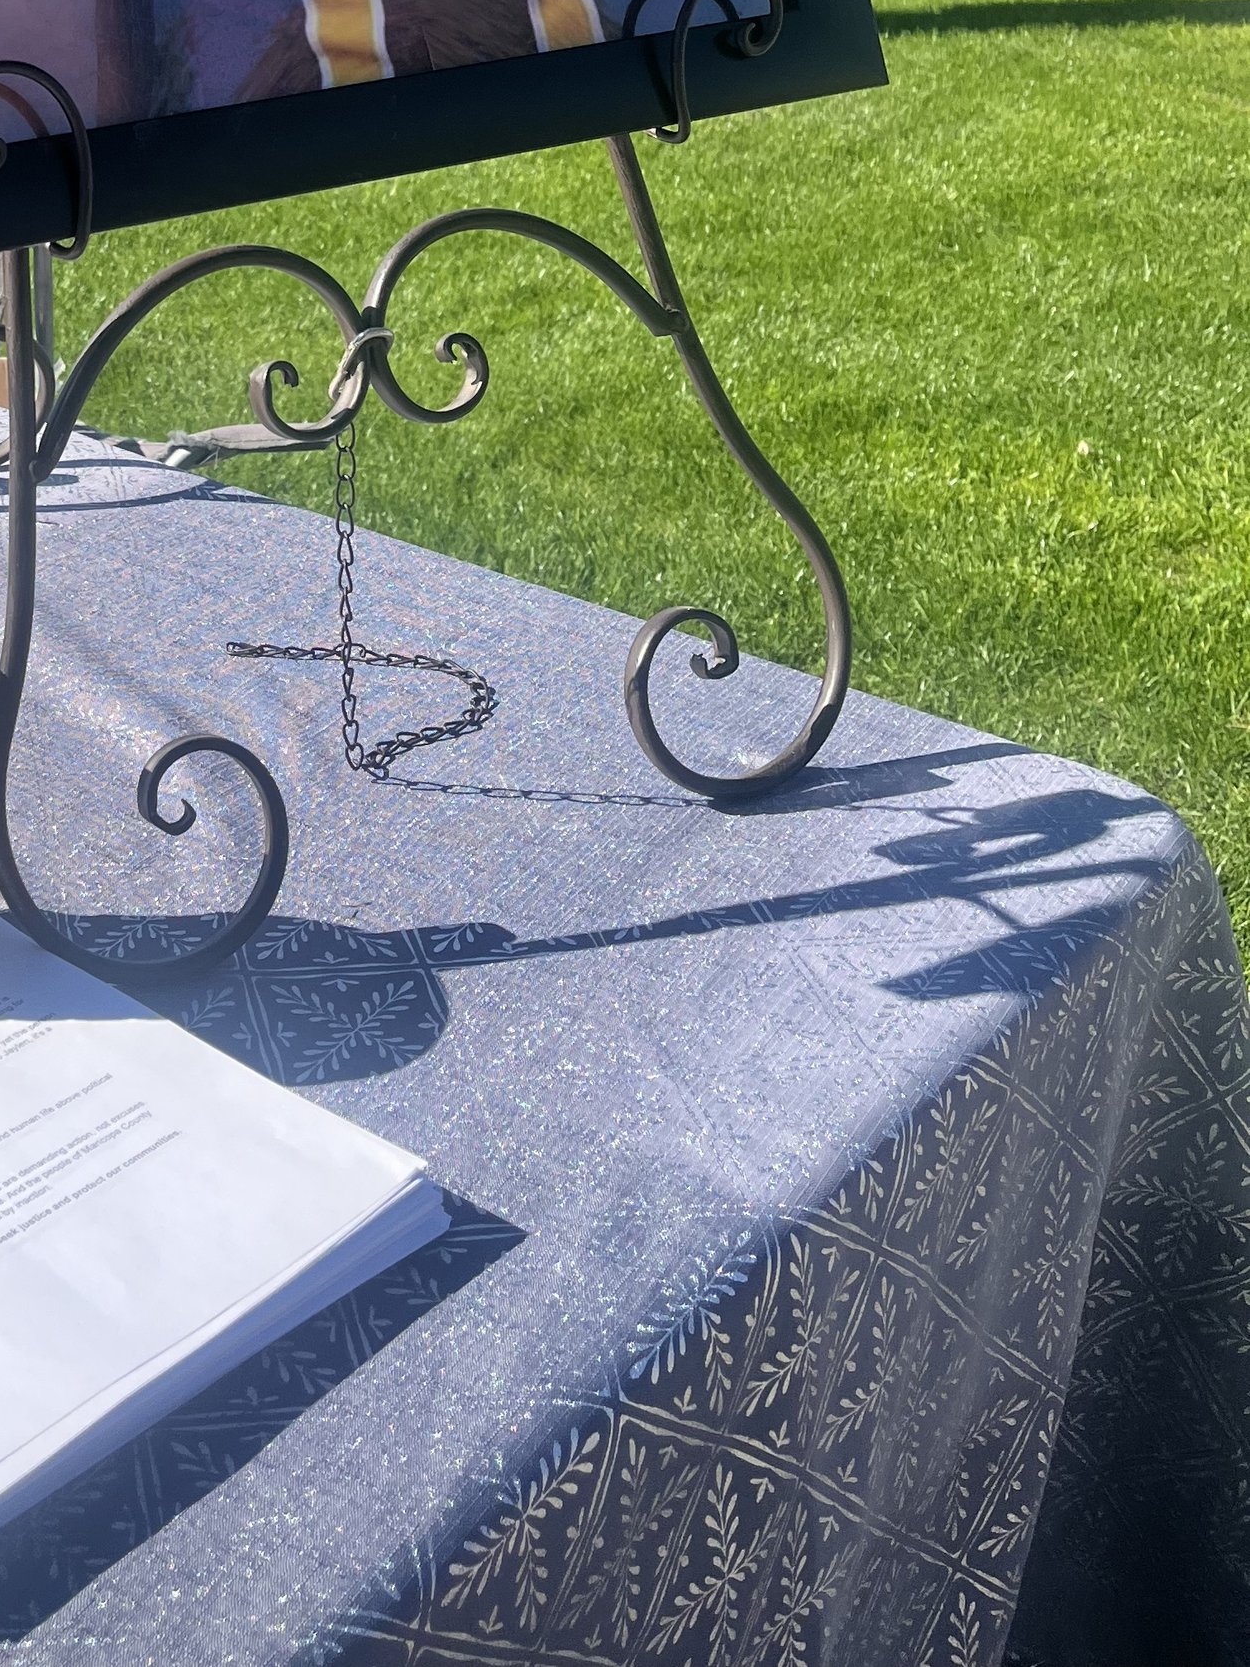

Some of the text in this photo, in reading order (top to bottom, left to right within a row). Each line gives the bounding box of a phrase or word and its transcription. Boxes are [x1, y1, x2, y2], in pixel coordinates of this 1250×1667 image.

[10, 1115, 41, 1133] human
[40, 1108, 55, 1116] life
[55, 1092, 82, 1108] above
[81, 1073, 113, 1094] political
[3, 1177, 19, 1187] are
[18, 1148, 68, 1177] demanding
[96, 1121, 111, 1131] not
[5, 1185, 27, 1198] And
[25, 1177, 42, 1187] the
[42, 1159, 72, 1179] people
[81, 1129, 122, 1153] Maricopa
[120, 1111, 154, 1130] County
[53, 1196, 71, 1210] and
[72, 1176, 106, 1200] protect
[106, 1166, 123, 1177] our
